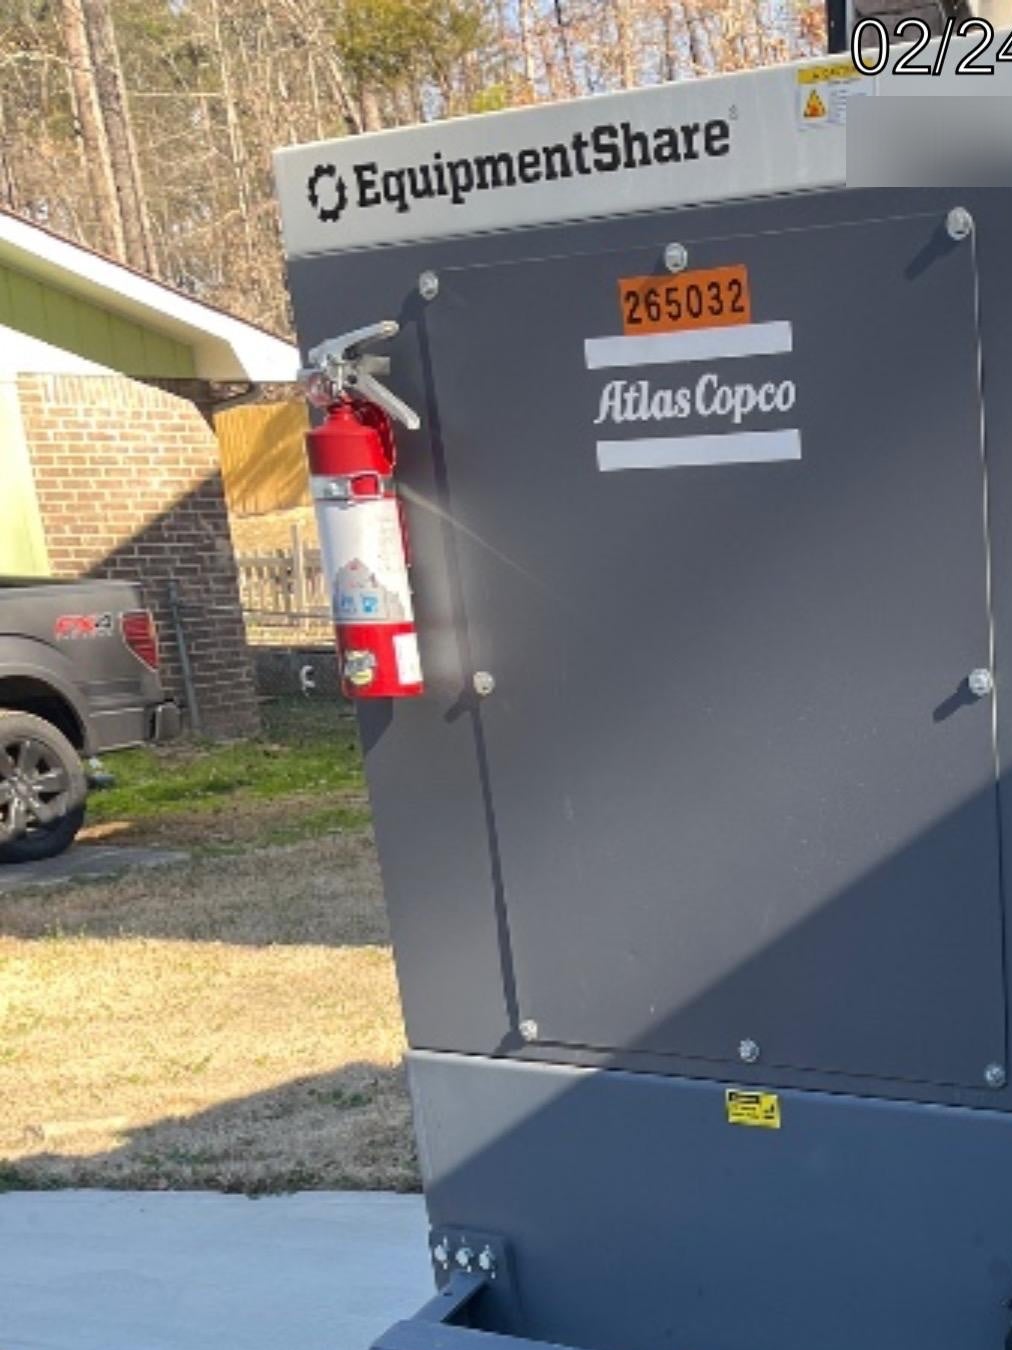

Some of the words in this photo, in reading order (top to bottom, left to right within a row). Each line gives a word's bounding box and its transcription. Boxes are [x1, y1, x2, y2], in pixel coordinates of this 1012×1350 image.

[353, 119, 731, 213] EquipmentShare
[624, 278, 745, 325] 265032
[593, 379, 691, 424] Atlas
[694, 372, 796, 424] Copco
